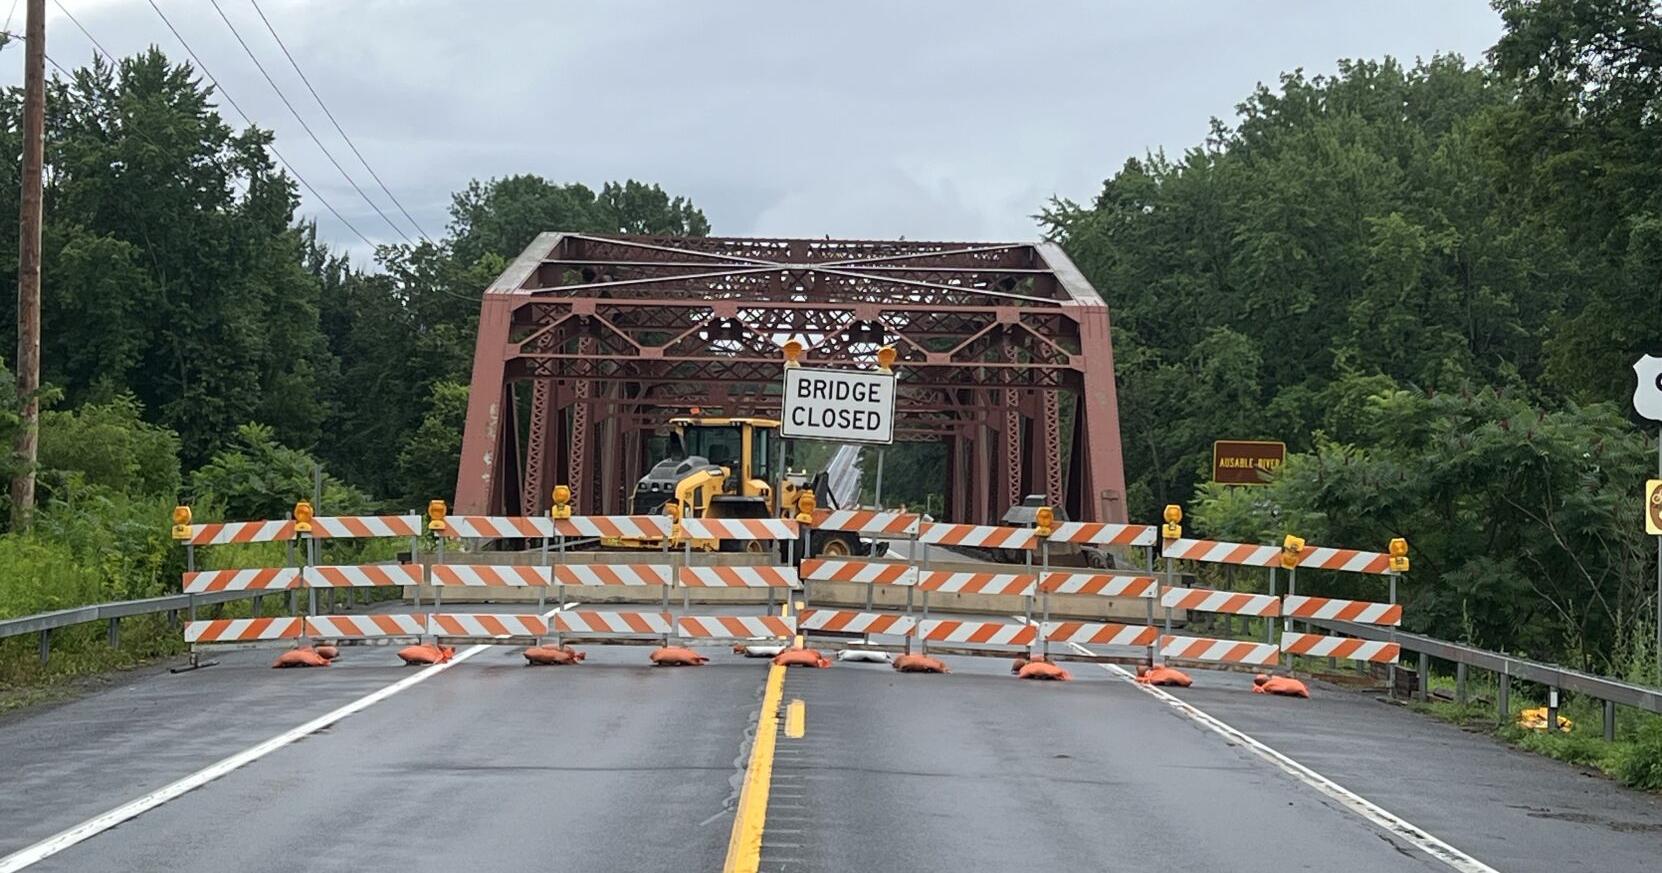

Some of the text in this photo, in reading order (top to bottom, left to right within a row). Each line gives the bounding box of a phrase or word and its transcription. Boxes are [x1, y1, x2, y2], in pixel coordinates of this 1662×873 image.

[797, 378, 881, 403] BRIDGE
[792, 406, 881, 431] CLOSED
[1219, 457, 1254, 468] AUSABLE
